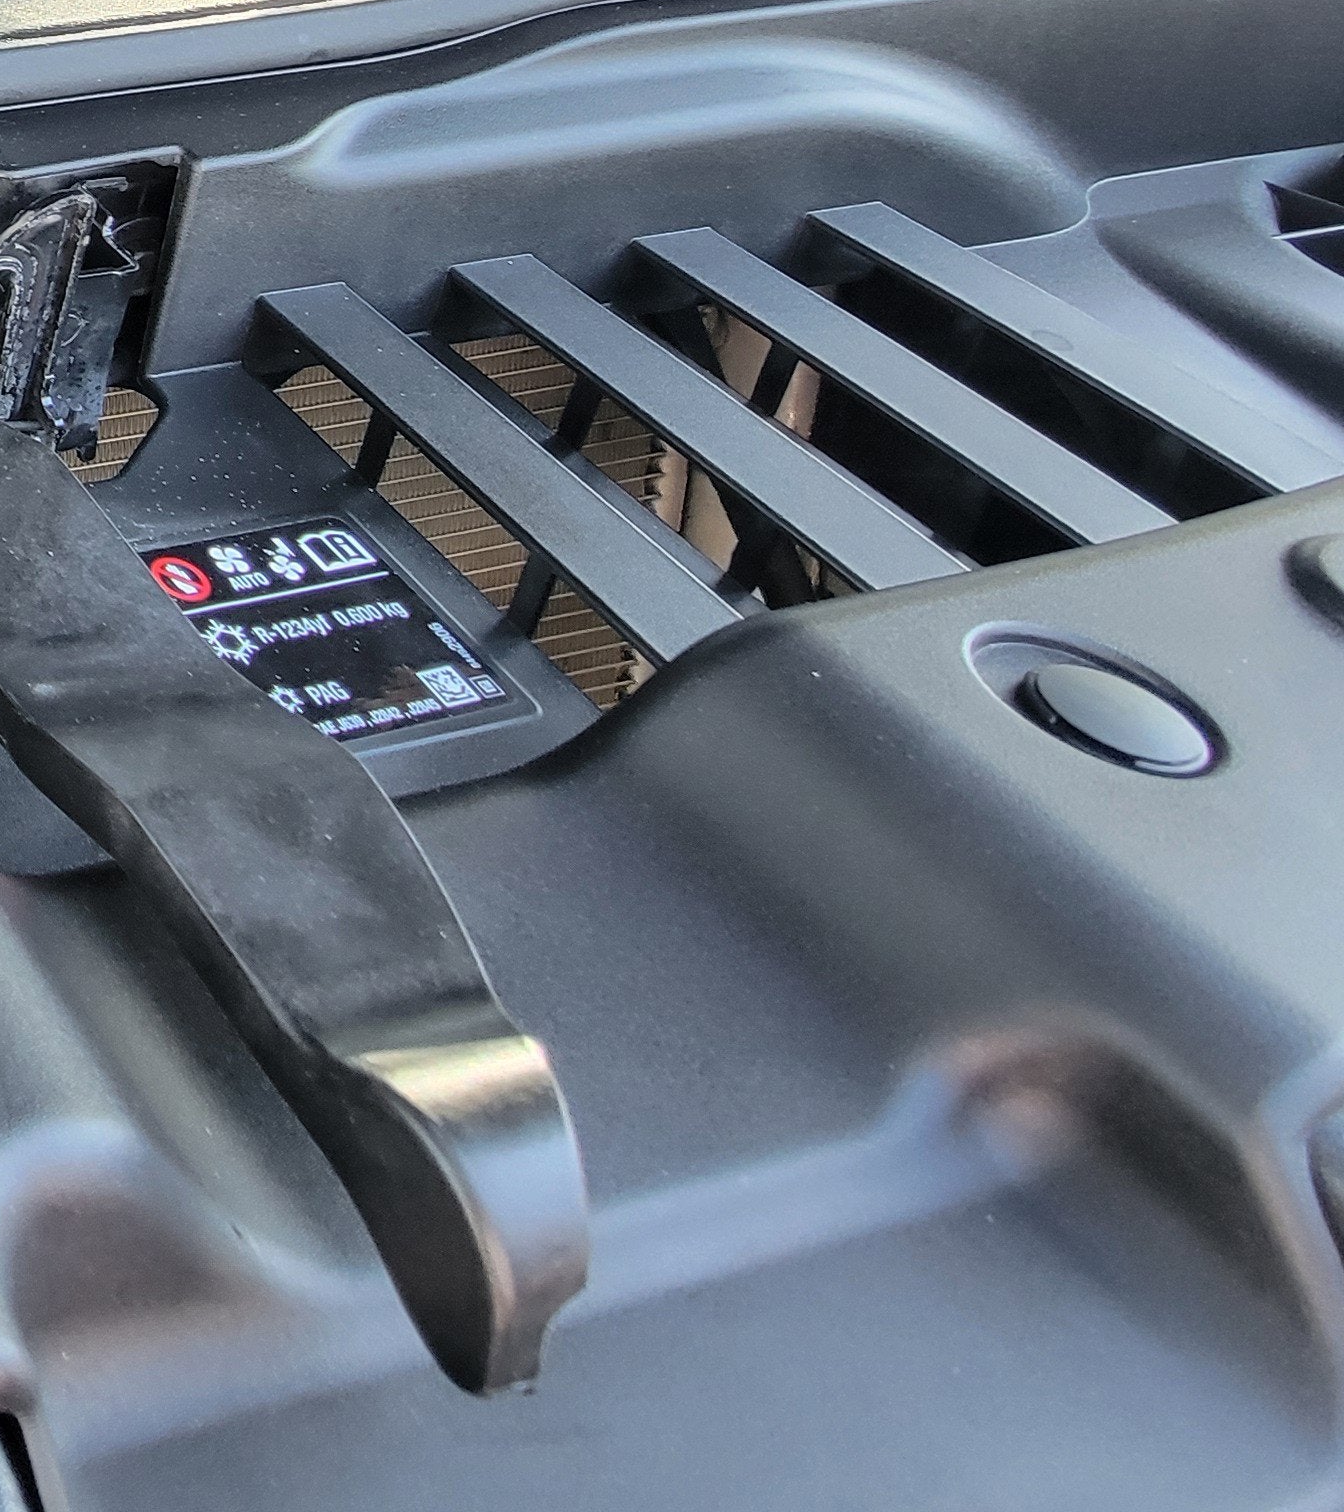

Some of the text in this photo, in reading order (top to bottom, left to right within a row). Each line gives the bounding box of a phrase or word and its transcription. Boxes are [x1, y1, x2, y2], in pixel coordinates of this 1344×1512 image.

[227, 572, 270, 592] AUTO
[252, 601, 410, 644] R-1234yf 0.600 kg
[304, 681, 351, 707] PAG
